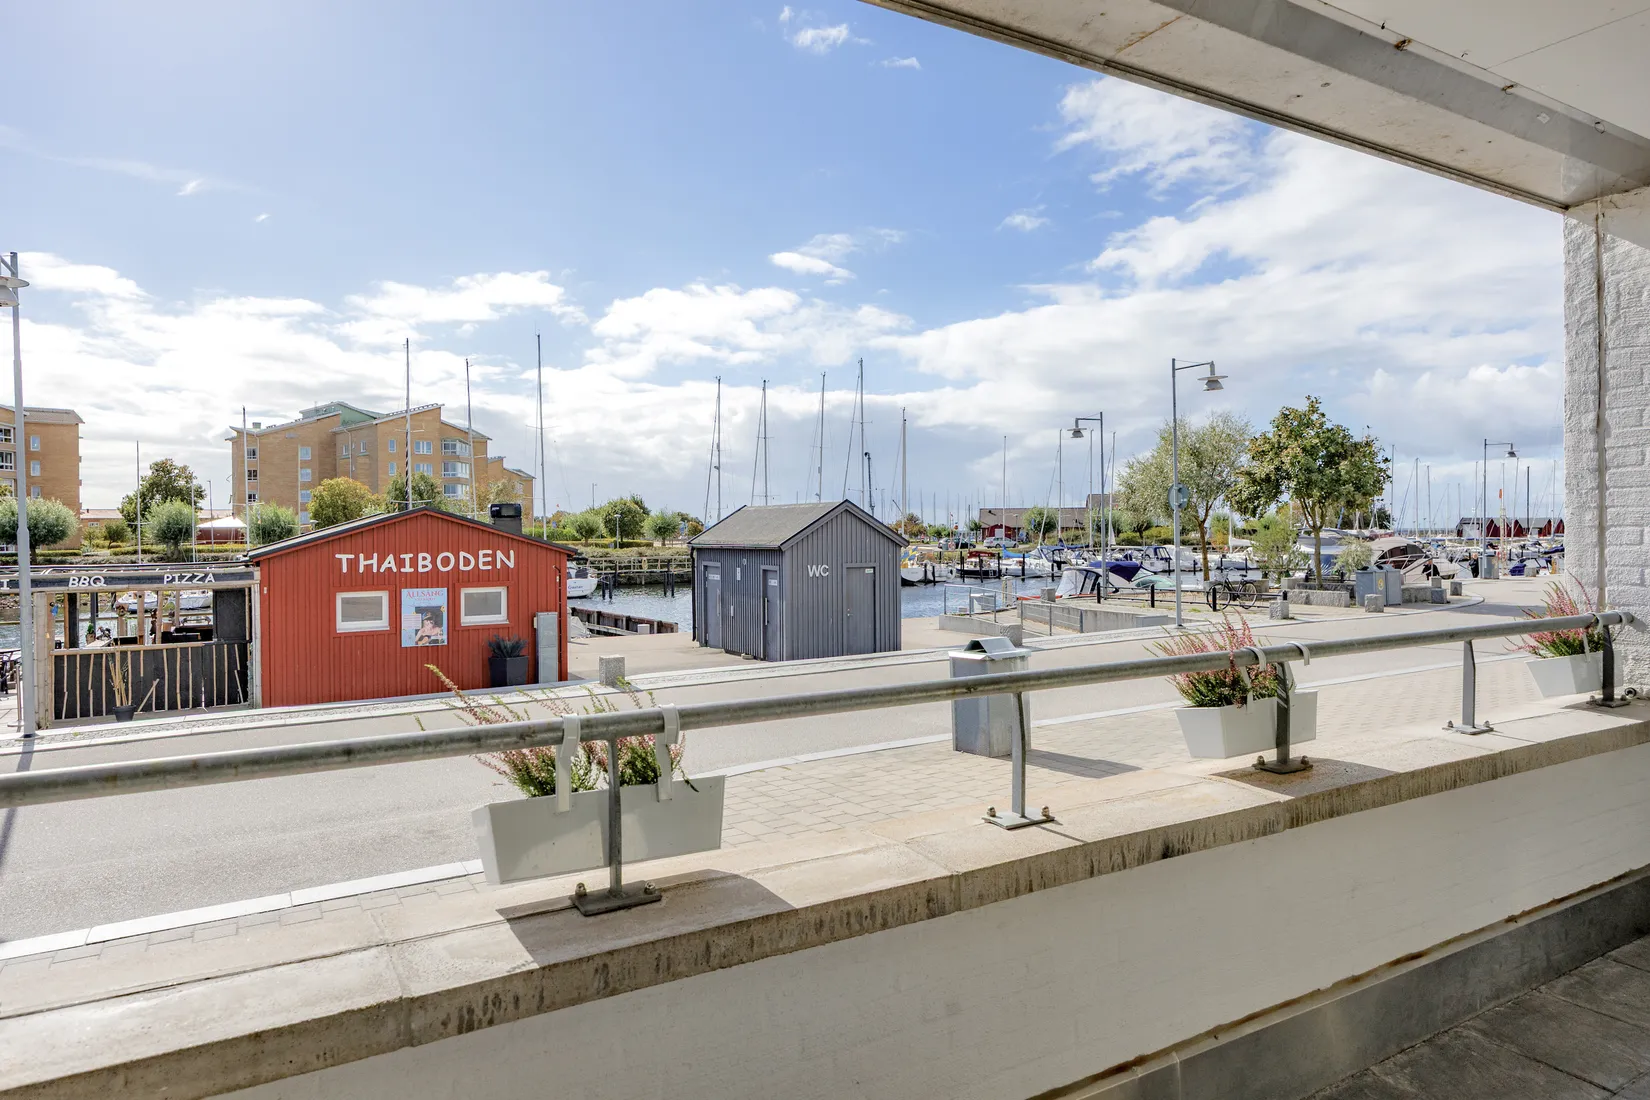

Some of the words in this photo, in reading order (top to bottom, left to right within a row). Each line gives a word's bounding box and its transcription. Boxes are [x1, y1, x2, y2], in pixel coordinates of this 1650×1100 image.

[335, 550, 515, 574] THAIBODEN
[807, 564, 829, 577] WC
[68, 575, 107, 588] BBQ
[163, 573, 216, 585] PIZZA
